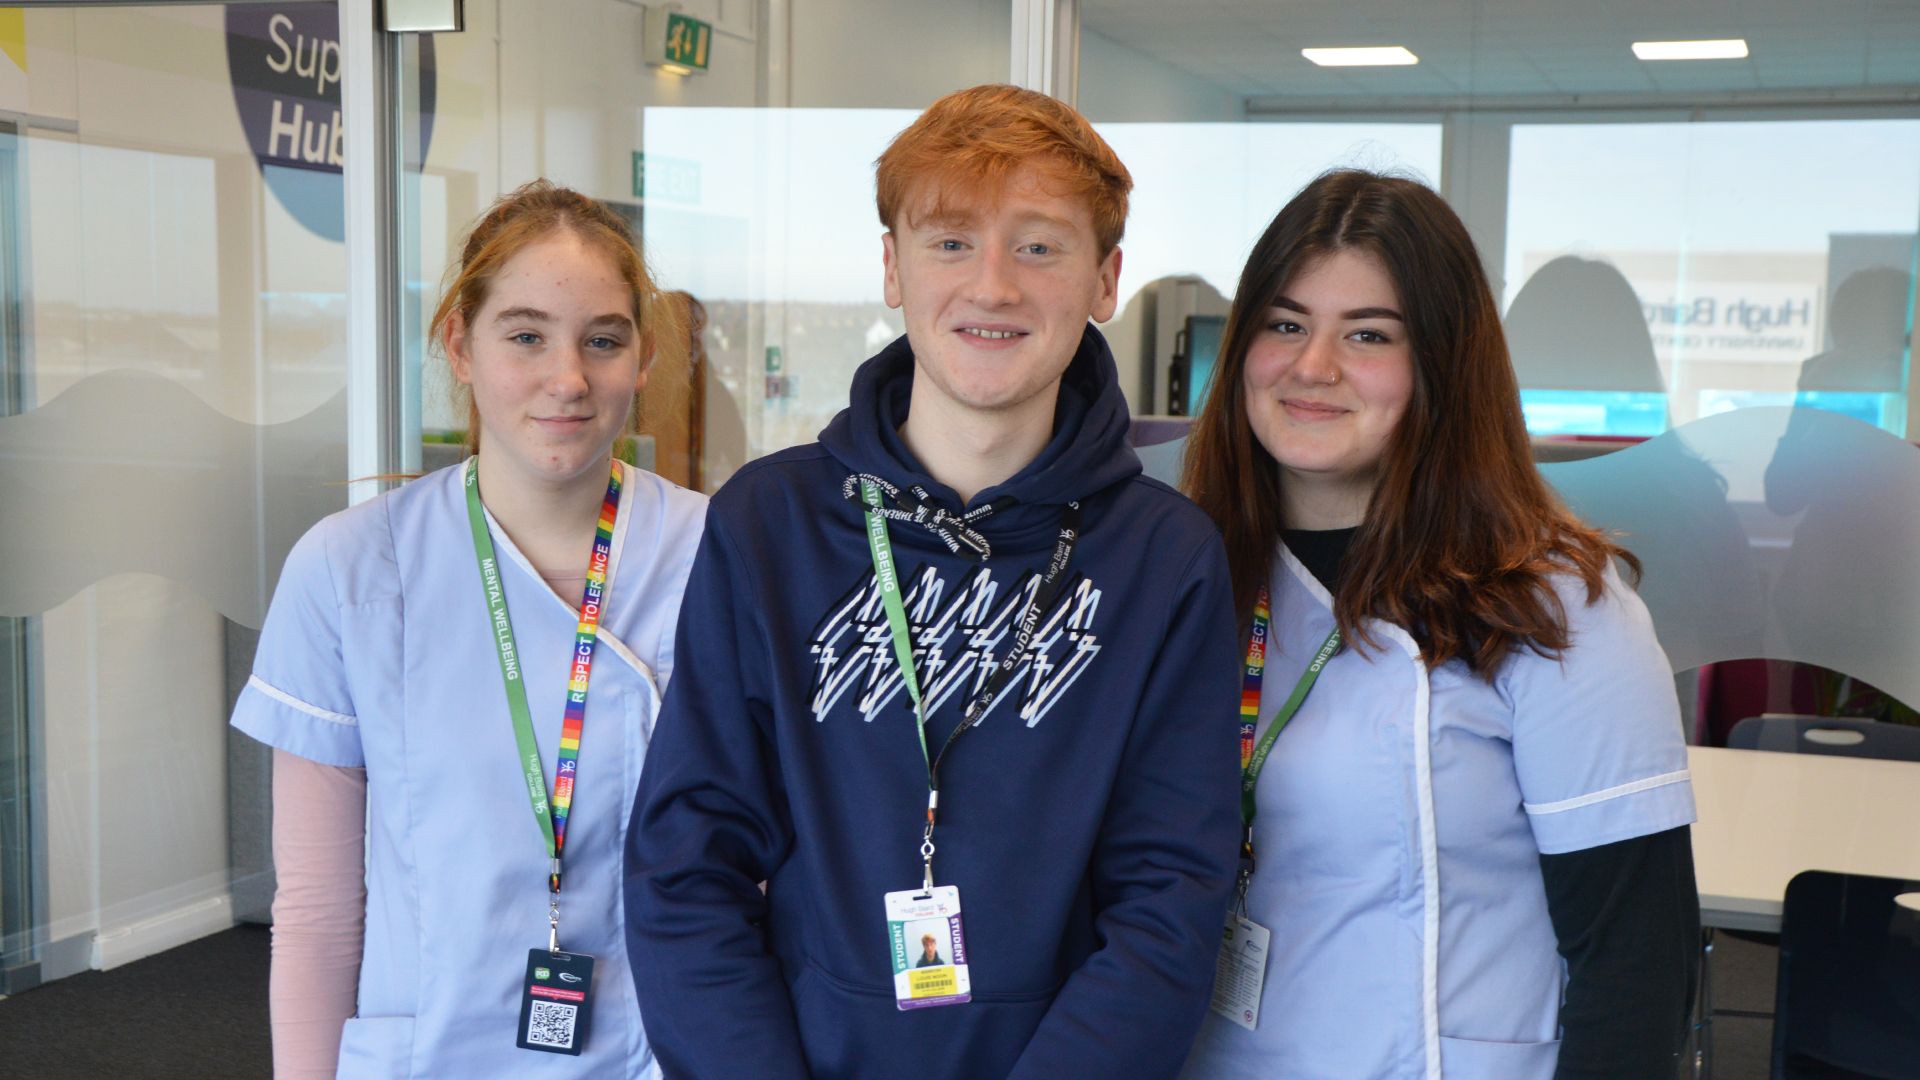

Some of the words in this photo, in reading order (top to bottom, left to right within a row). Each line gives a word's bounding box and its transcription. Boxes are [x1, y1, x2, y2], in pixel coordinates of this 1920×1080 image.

[871, 516, 895, 593] WELLBEING
[1044, 560, 1059, 584] Hugh
[1053, 541, 1066, 562] Baird
[1059, 545, 1072, 570] COLLEGE
[482, 558, 498, 607] MENTAL
[494, 608, 519, 680] WELLBEING
[571, 637, 592, 703] RESPECT
[583, 543, 609, 621] TOLERANCE
[1003, 602, 1042, 671] STUDENT
[1247, 618, 1265, 677] RESPECT
[892, 924, 907, 970] STUDENT
[950, 917, 964, 963] STUDENT
